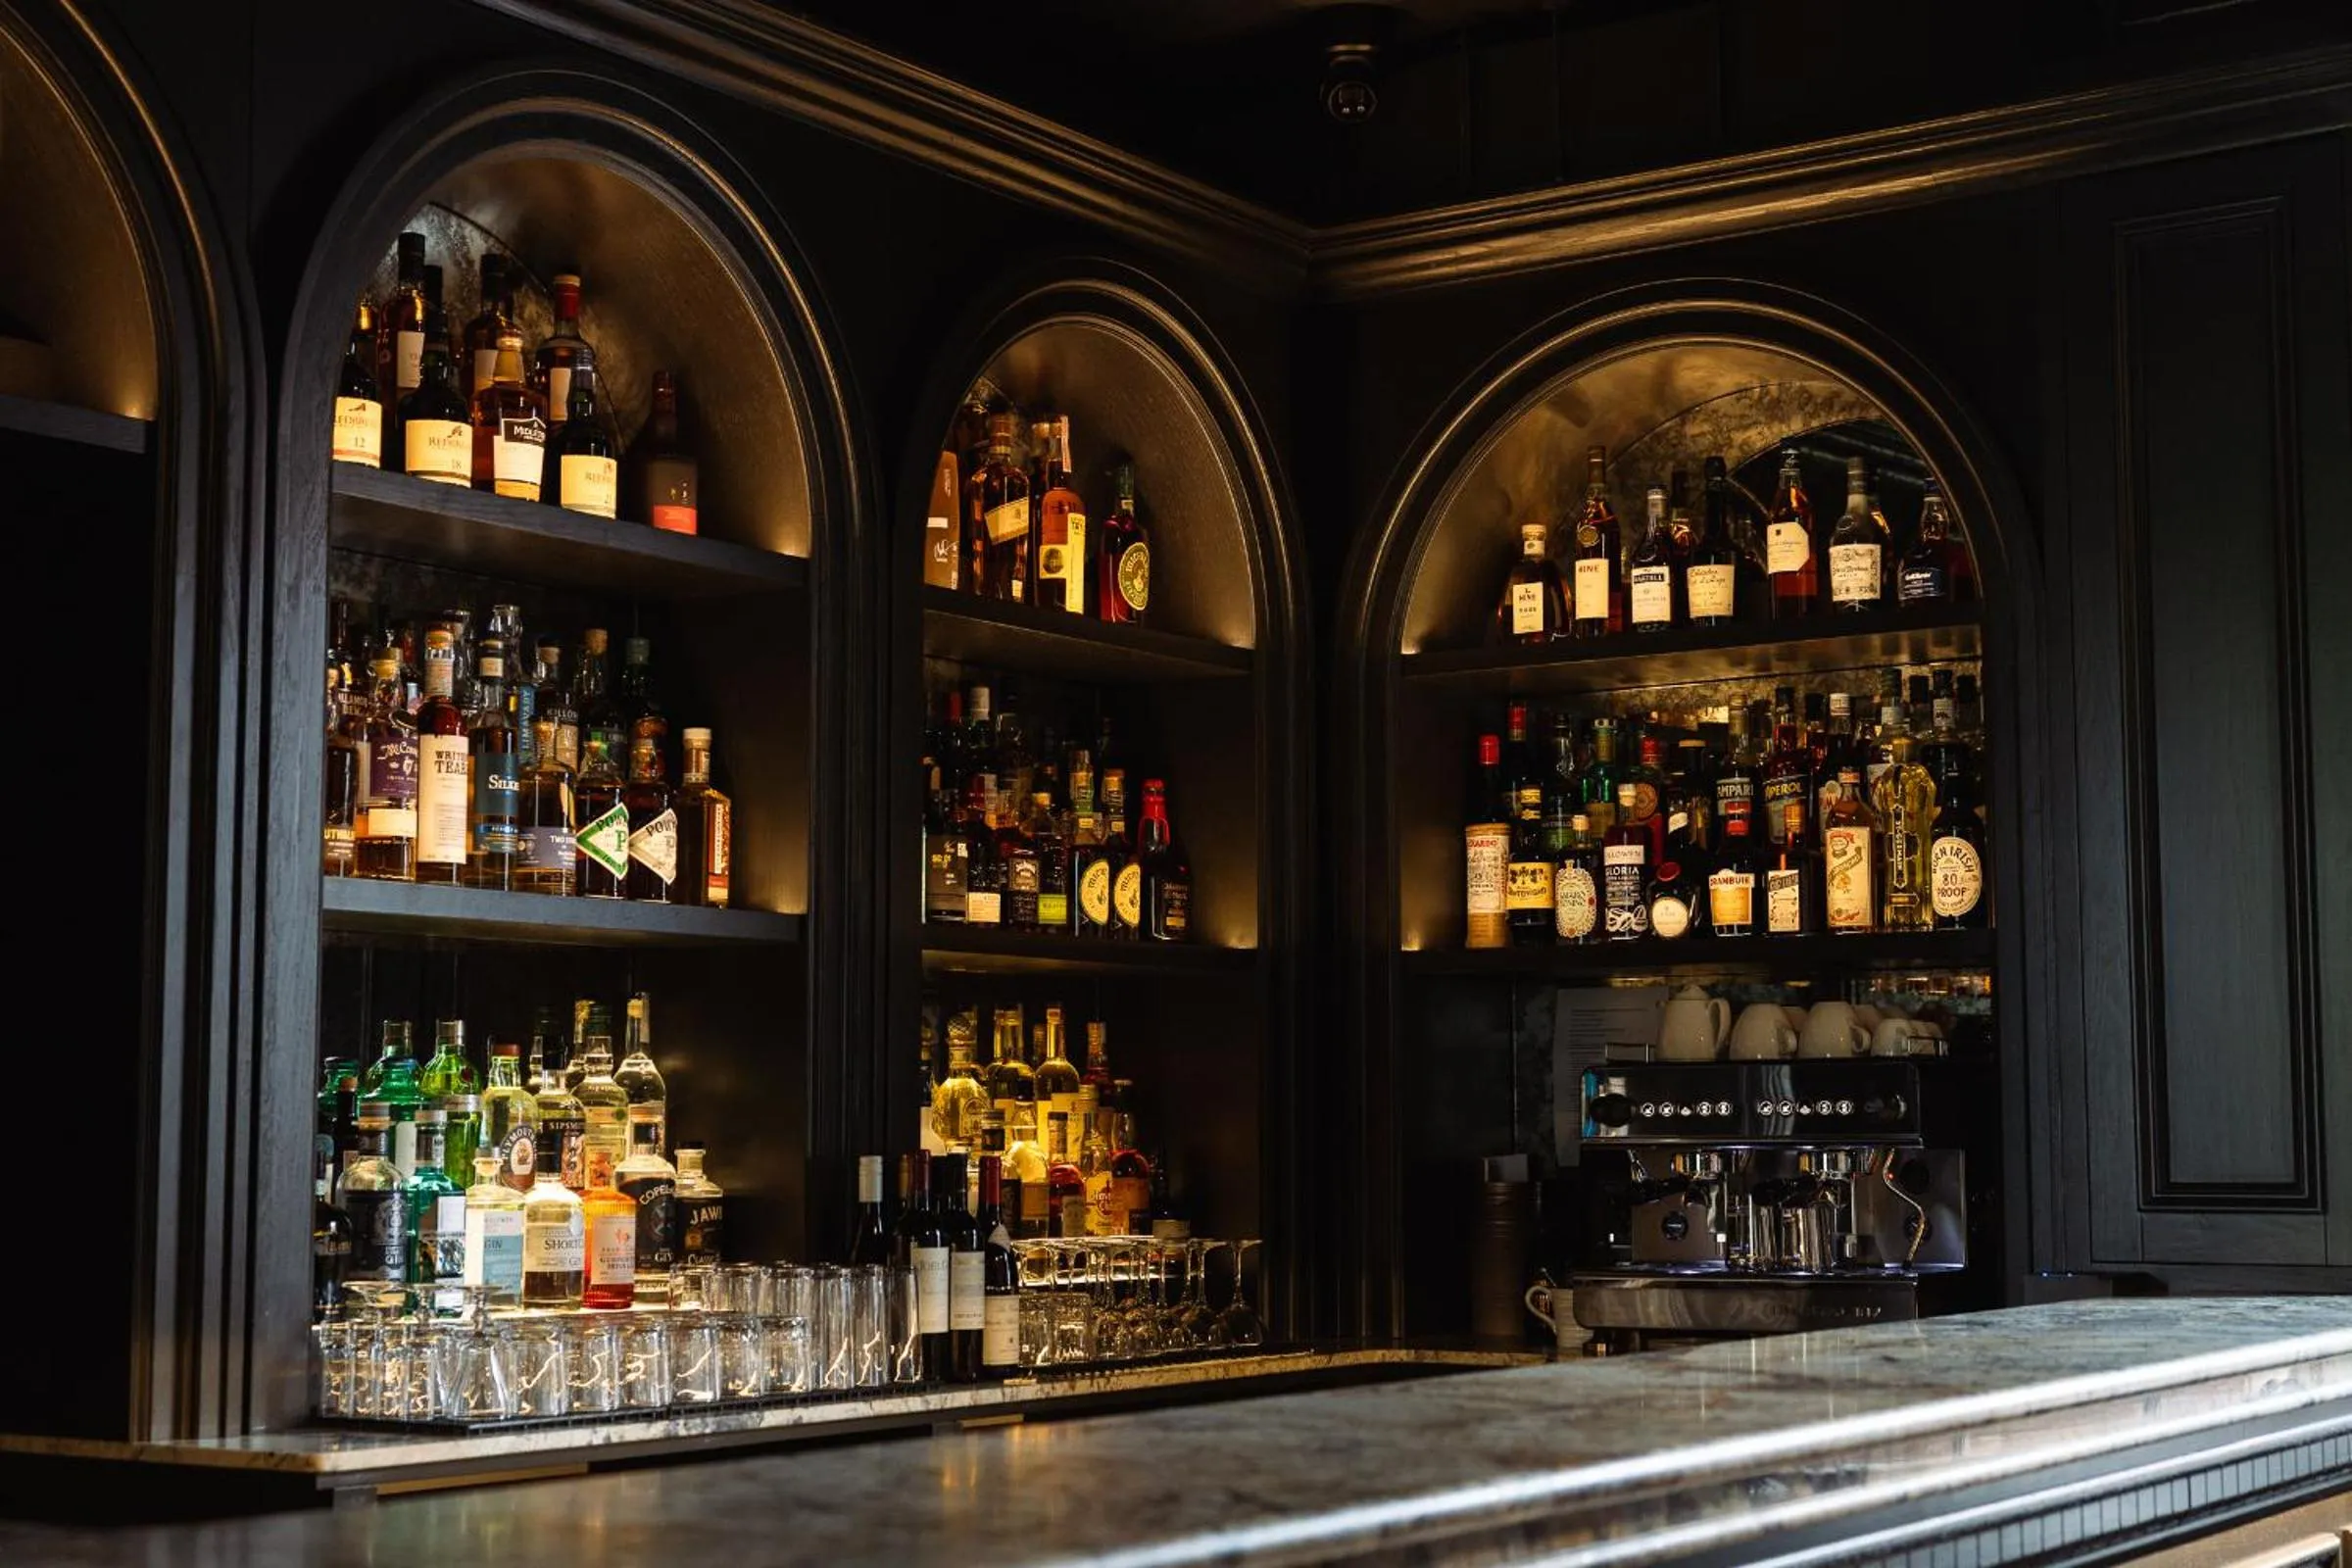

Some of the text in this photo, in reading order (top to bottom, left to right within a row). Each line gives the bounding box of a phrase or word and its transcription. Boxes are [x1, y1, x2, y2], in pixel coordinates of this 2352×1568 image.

[354, 437, 366, 448] 12
[1950, 846, 1976, 873] IRISH
[1605, 865, 1640, 876] GLORIA
[1941, 873, 1958, 886] 80
